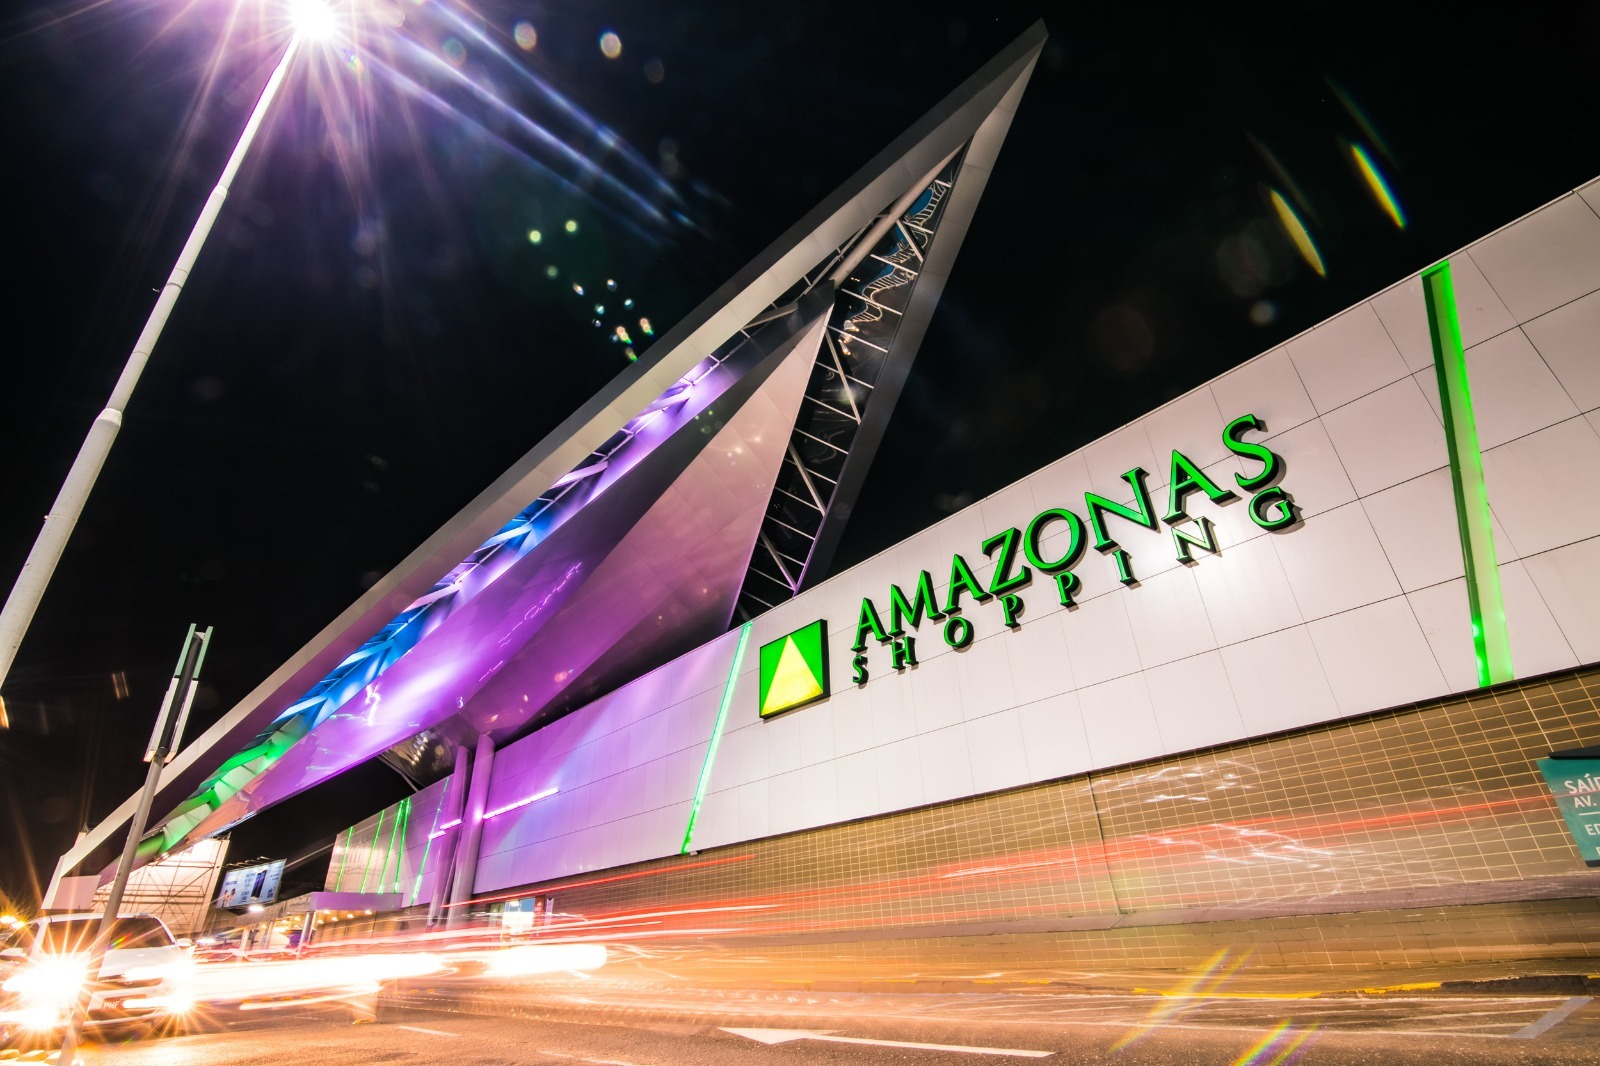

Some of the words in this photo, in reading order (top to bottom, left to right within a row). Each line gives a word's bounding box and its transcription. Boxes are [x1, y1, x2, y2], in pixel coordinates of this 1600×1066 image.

[850, 413, 1279, 652] AMAZONAS
[852, 486, 1298, 685] SHOPPING
[1574, 795, 1597, 809] AV.
